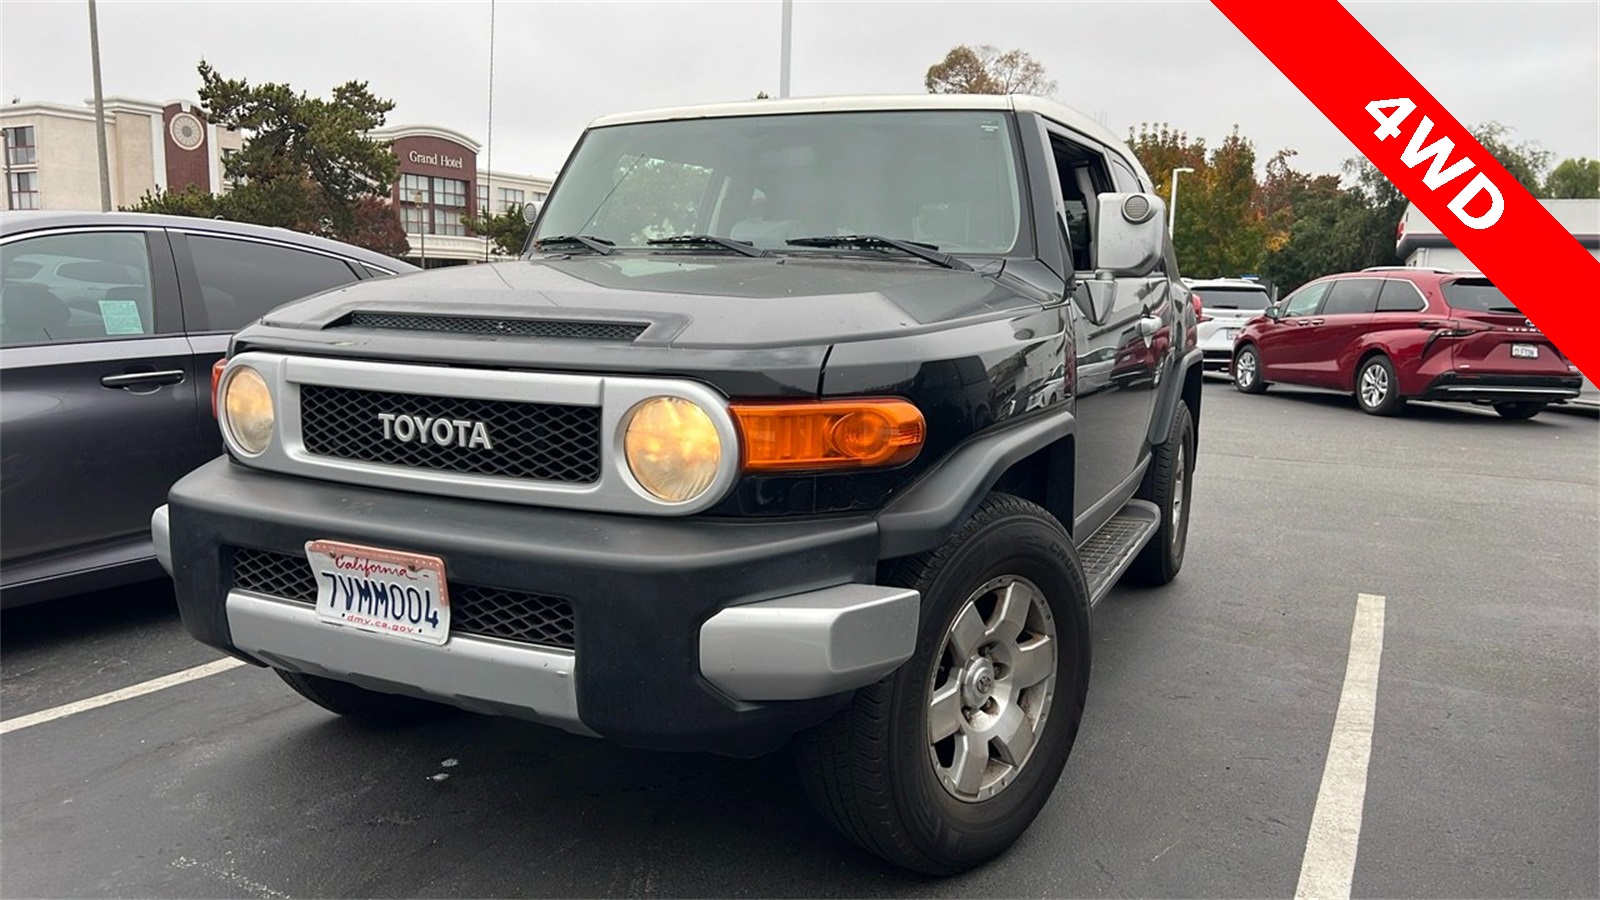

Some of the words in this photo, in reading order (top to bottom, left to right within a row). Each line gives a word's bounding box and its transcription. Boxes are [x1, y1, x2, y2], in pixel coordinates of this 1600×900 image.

[409, 150, 438, 166] Grand
[440, 155, 463, 170] Hotel
[378, 413, 493, 450] TOYOTA
[335, 554, 418, 578] California
[321, 571, 440, 629] 7VMM004
[346, 614, 415, 634] dmv.ca.gov
